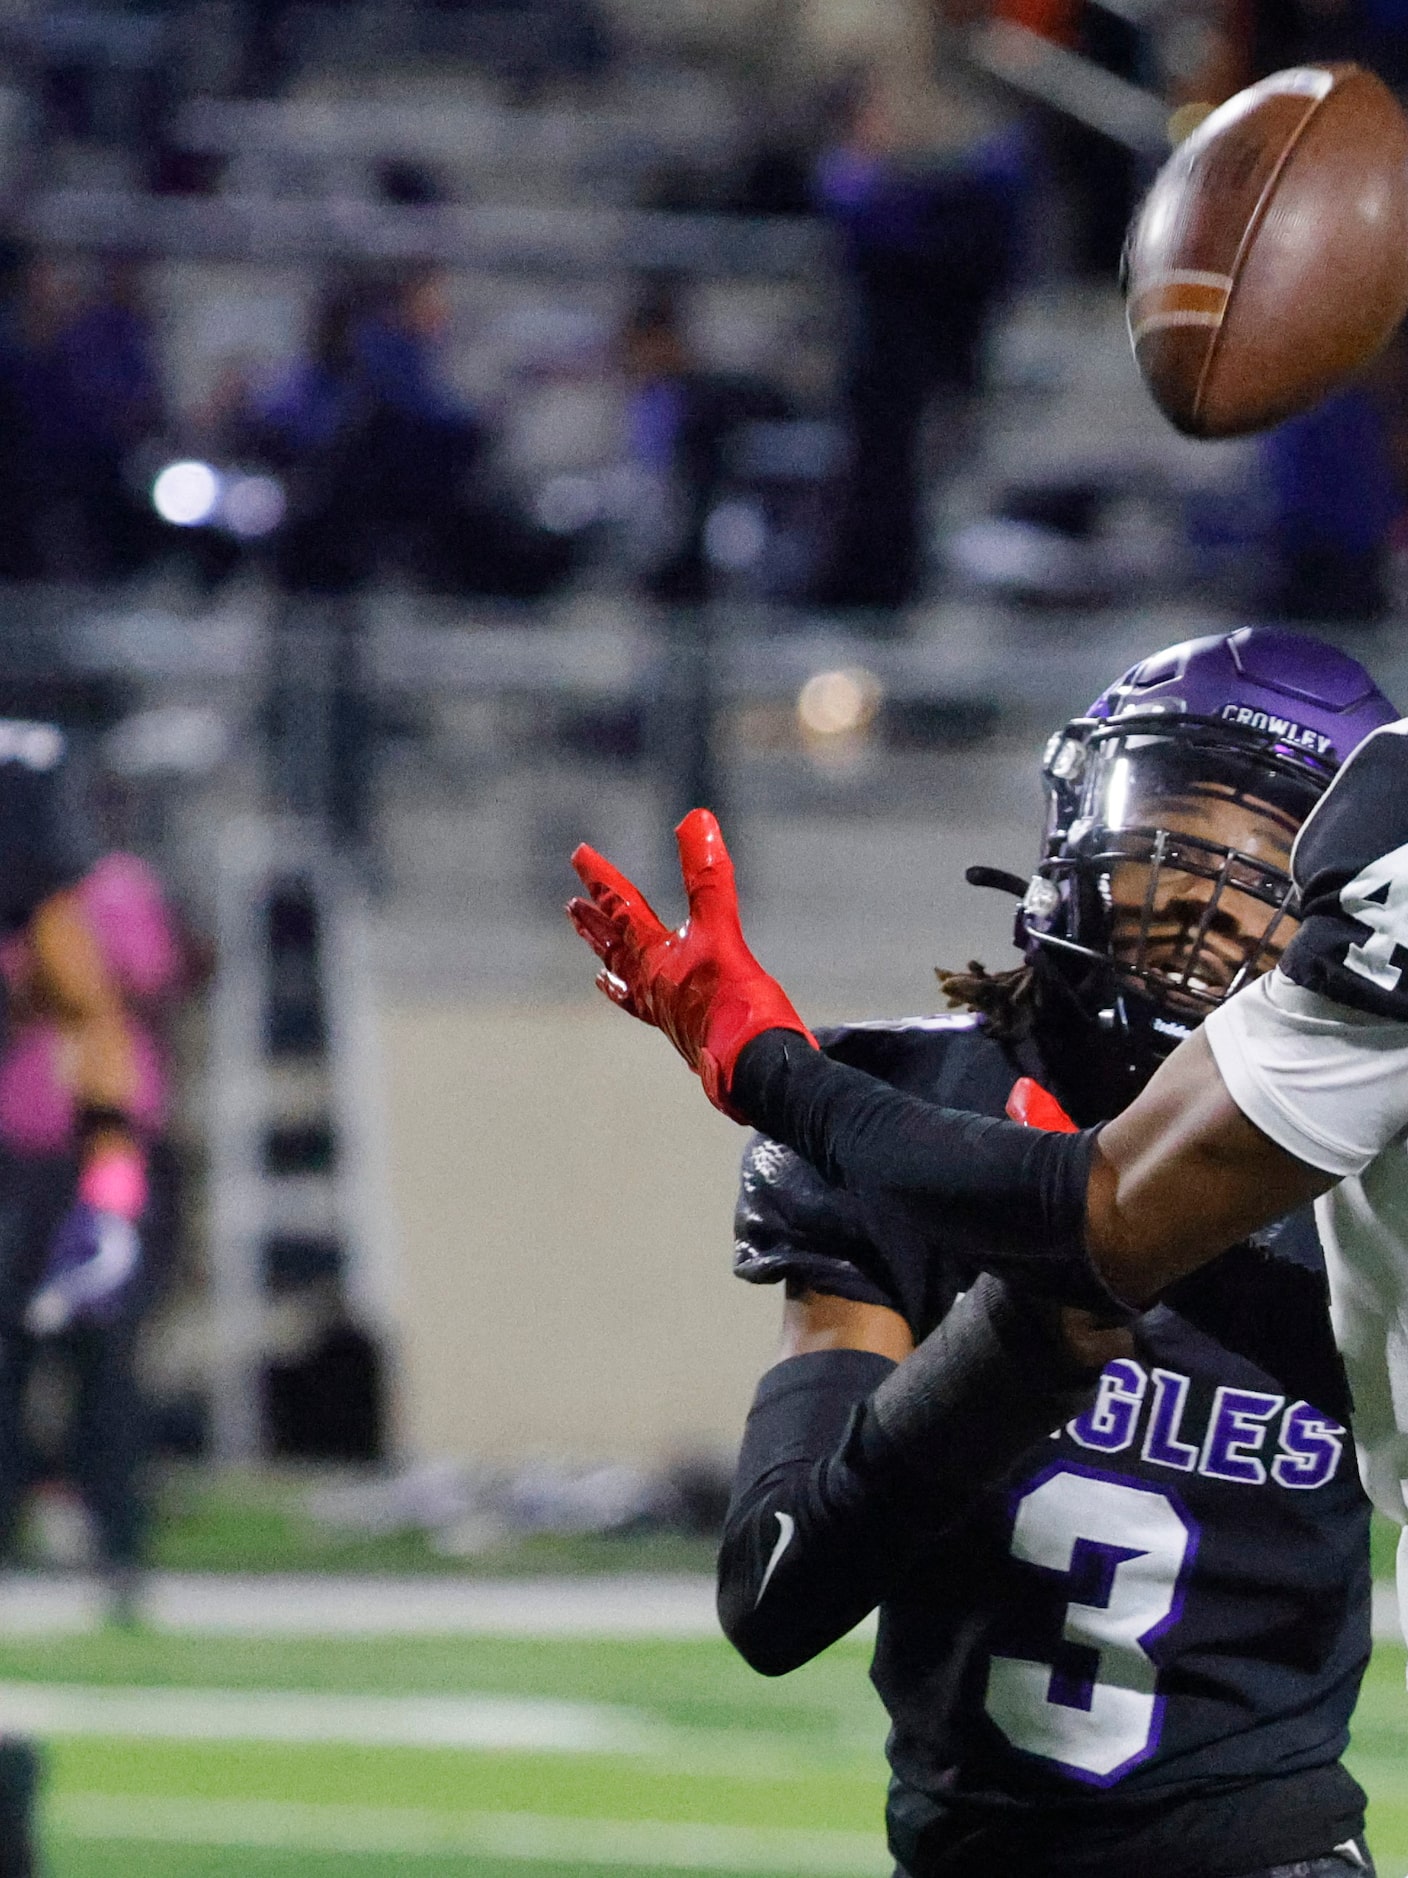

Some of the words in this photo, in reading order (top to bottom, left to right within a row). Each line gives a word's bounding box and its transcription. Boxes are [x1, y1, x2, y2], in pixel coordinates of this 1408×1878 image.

[1221, 704, 1331, 753] CROWLEY
[1050, 1357, 1347, 1490] GLES
[983, 1461, 1200, 1788] 3
